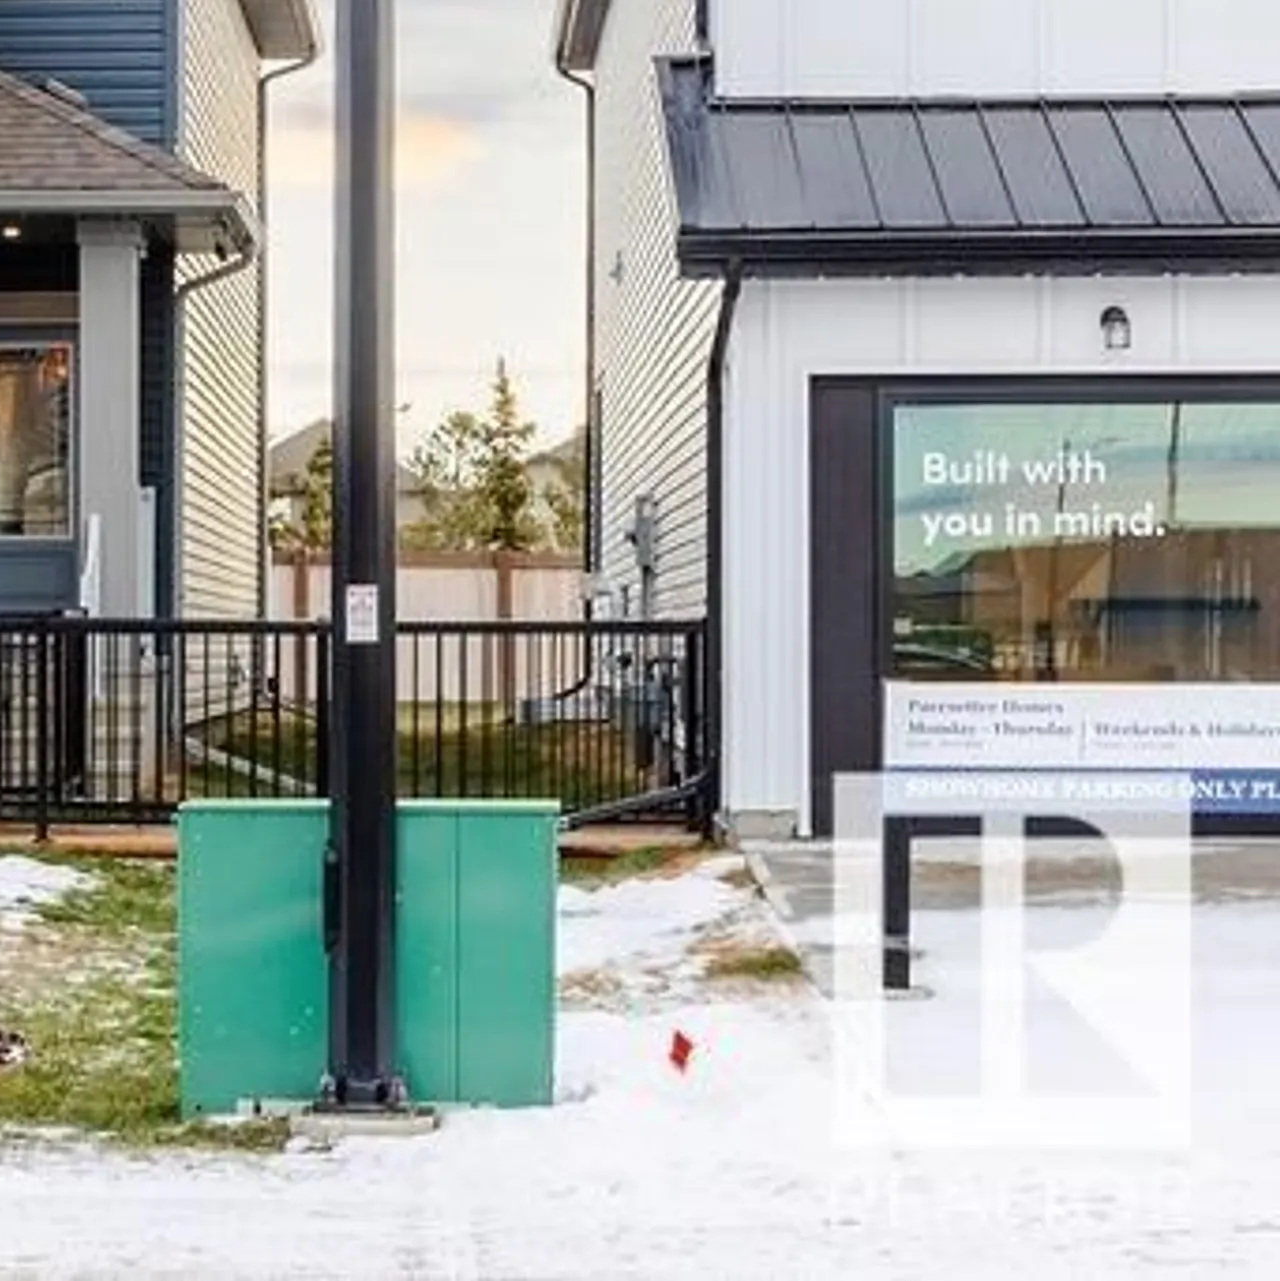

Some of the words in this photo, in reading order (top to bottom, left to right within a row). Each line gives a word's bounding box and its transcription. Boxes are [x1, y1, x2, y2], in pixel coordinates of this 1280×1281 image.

[923, 452, 1011, 484] Built
[1022, 450, 1106, 484] with
[920, 511, 992, 546] you
[1005, 502, 1041, 536] in
[1054, 500, 1166, 536] mind.
[1177, 780, 1247, 800] ONLY
